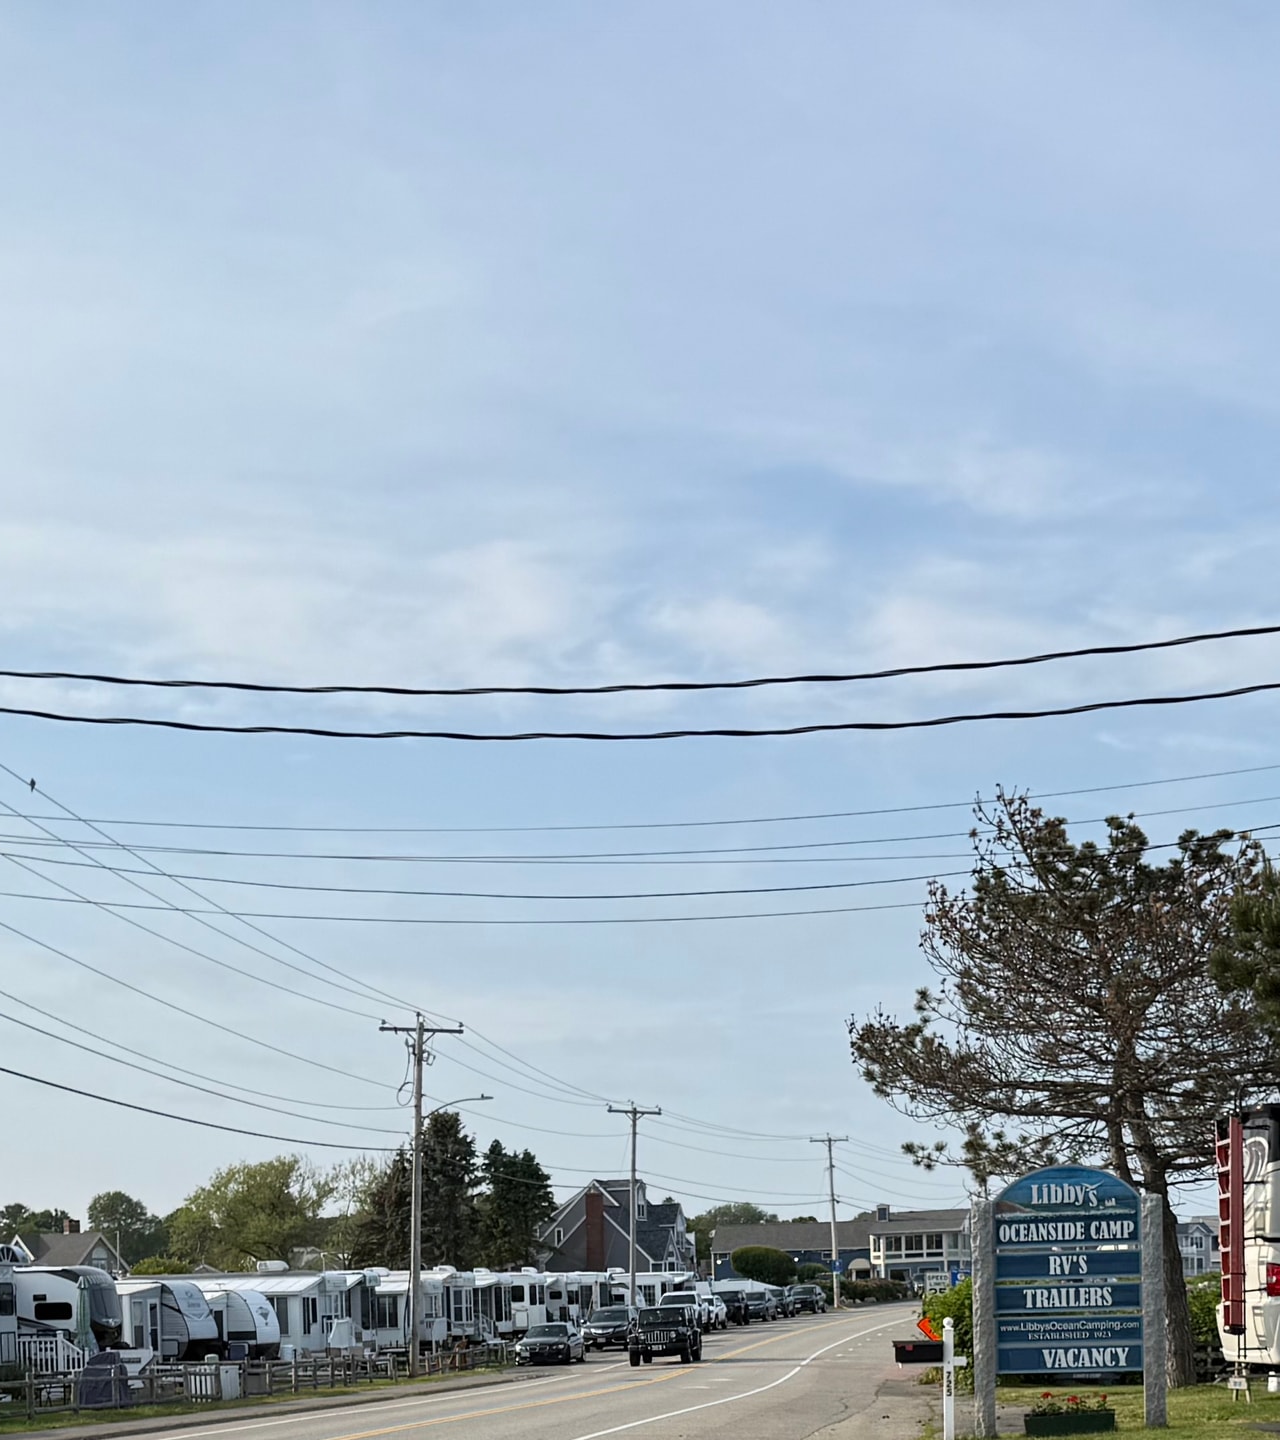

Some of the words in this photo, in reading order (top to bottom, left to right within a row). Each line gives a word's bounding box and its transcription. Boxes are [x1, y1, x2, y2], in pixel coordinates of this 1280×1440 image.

[1030, 1182, 1098, 1207] Libby's
[999, 1221, 1085, 1243] OCEANSIDE
[1090, 1220, 1135, 1240] CAMP
[1048, 1255, 1088, 1275] RV'S
[1023, 1286, 1113, 1309] TRAILERS
[1000, 1320, 1140, 1332] www.LibbysOceanCamping.com
[1028, 1331, 1090, 1340] ESTABLISHED
[1042, 1347, 1130, 1369] VACANCY
